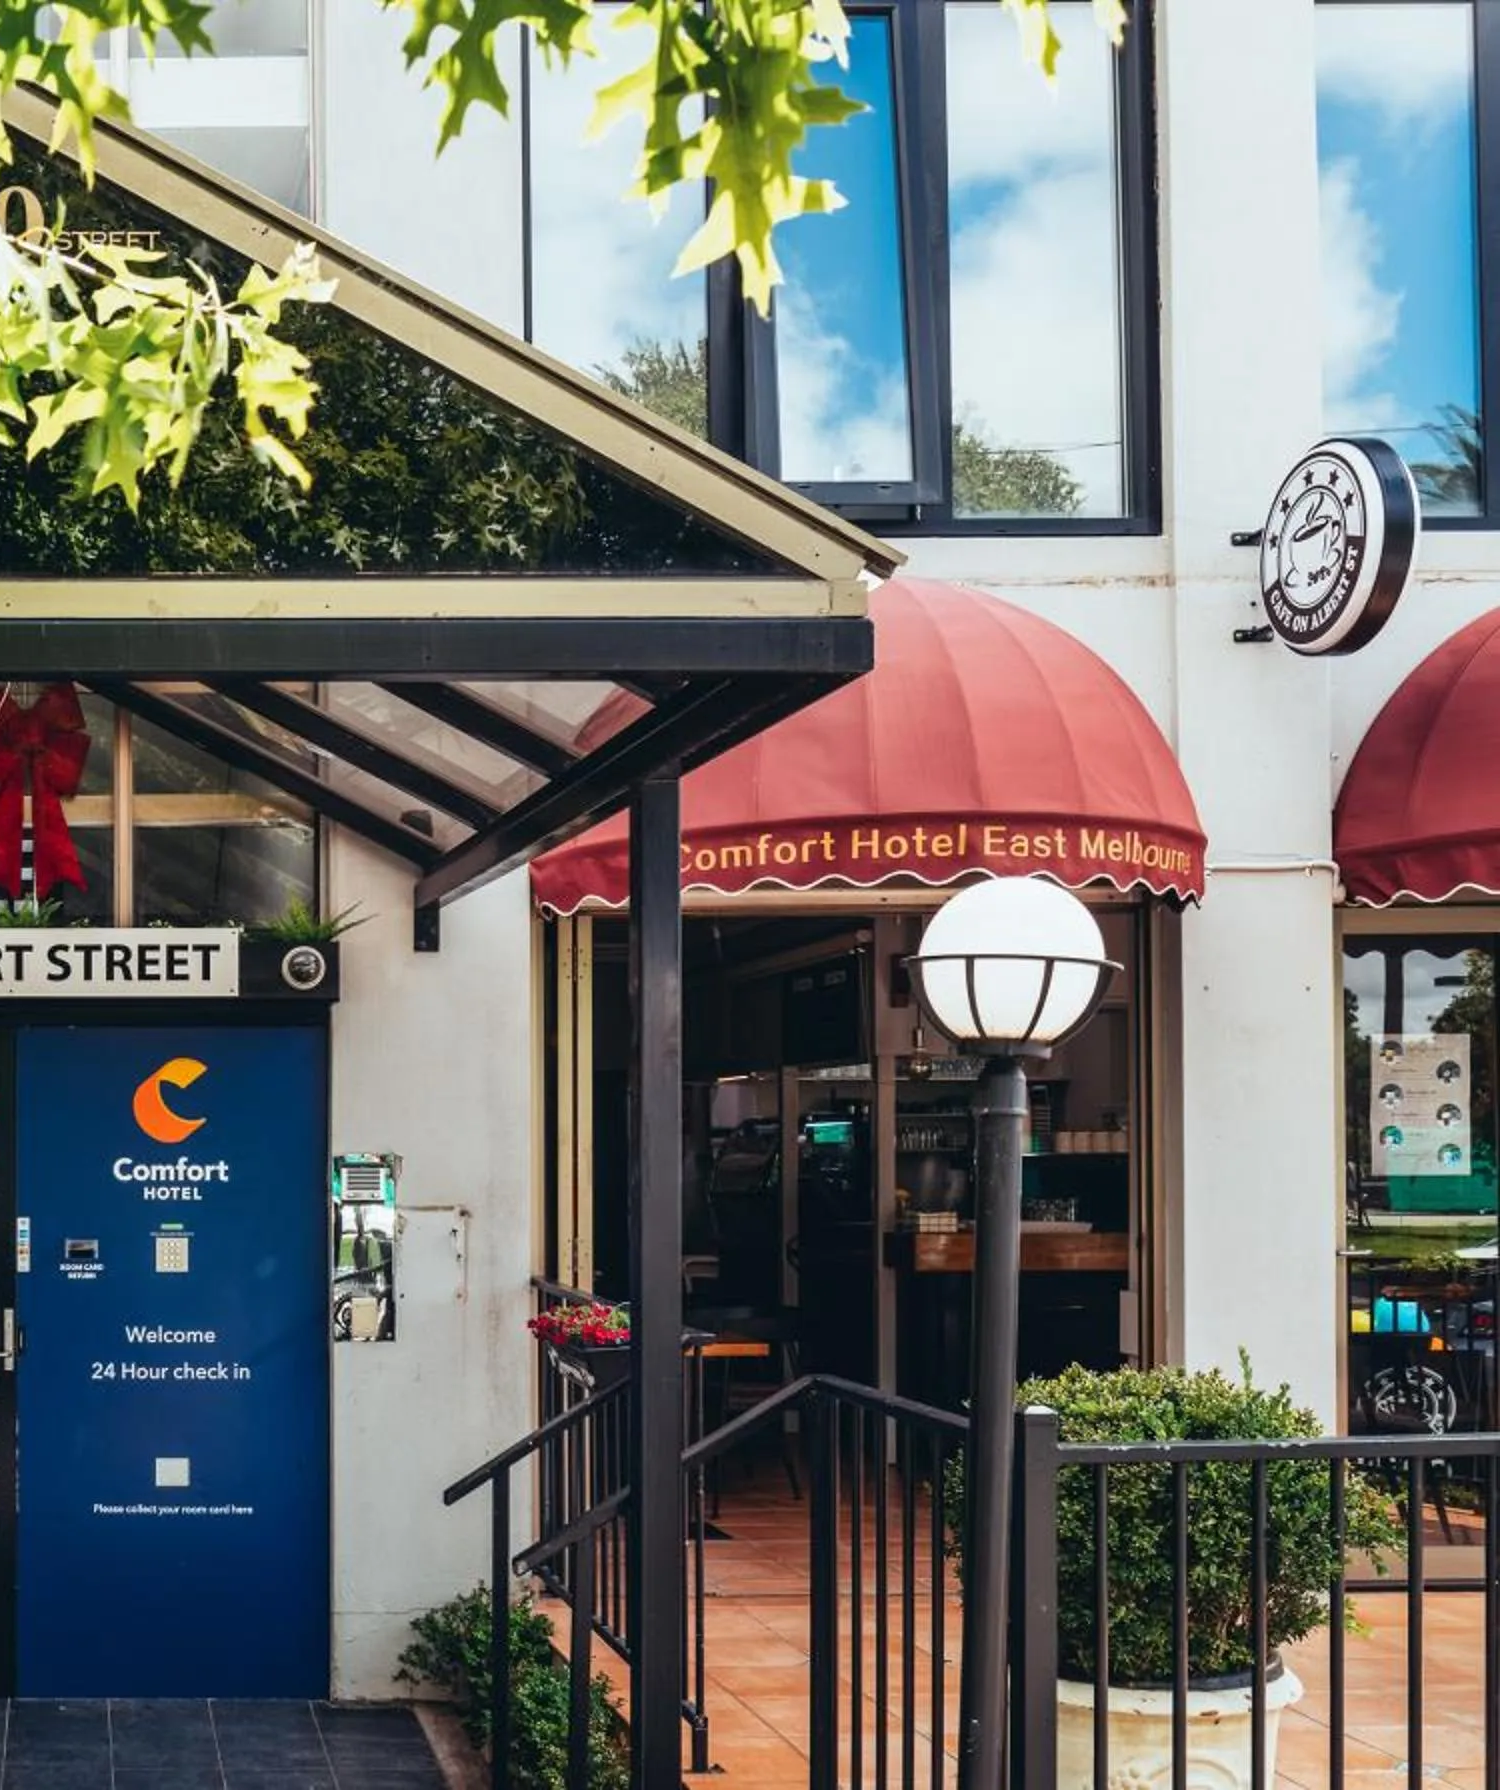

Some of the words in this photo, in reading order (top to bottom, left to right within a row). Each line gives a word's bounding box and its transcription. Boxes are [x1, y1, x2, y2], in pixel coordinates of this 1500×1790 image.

[1292, 615, 1309, 632] ON
[1310, 573, 1350, 631] ALBERT
[1345, 545, 1359, 572] ST
[852, 824, 967, 859] Hotel
[982, 826, 1067, 859] East
[1080, 828, 1192, 876] Melbourne
[46, 944, 221, 982] STREET
[113, 1156, 229, 1183] Comfort
[143, 1186, 203, 1201] HOTEL
[125, 1325, 216, 1344] Welcome
[91, 1362, 116, 1380] 24
[121, 1362, 168, 1380] Hour
[173, 1361, 228, 1380] check
[233, 1362, 251, 1380] in
[93, 1503, 124, 1514] Please
[125, 1503, 157, 1514] collect
[158, 1505, 180, 1517] your
[181, 1505, 207, 1514] room
[209, 1504, 230, 1514] card
[231, 1504, 253, 1514] here
